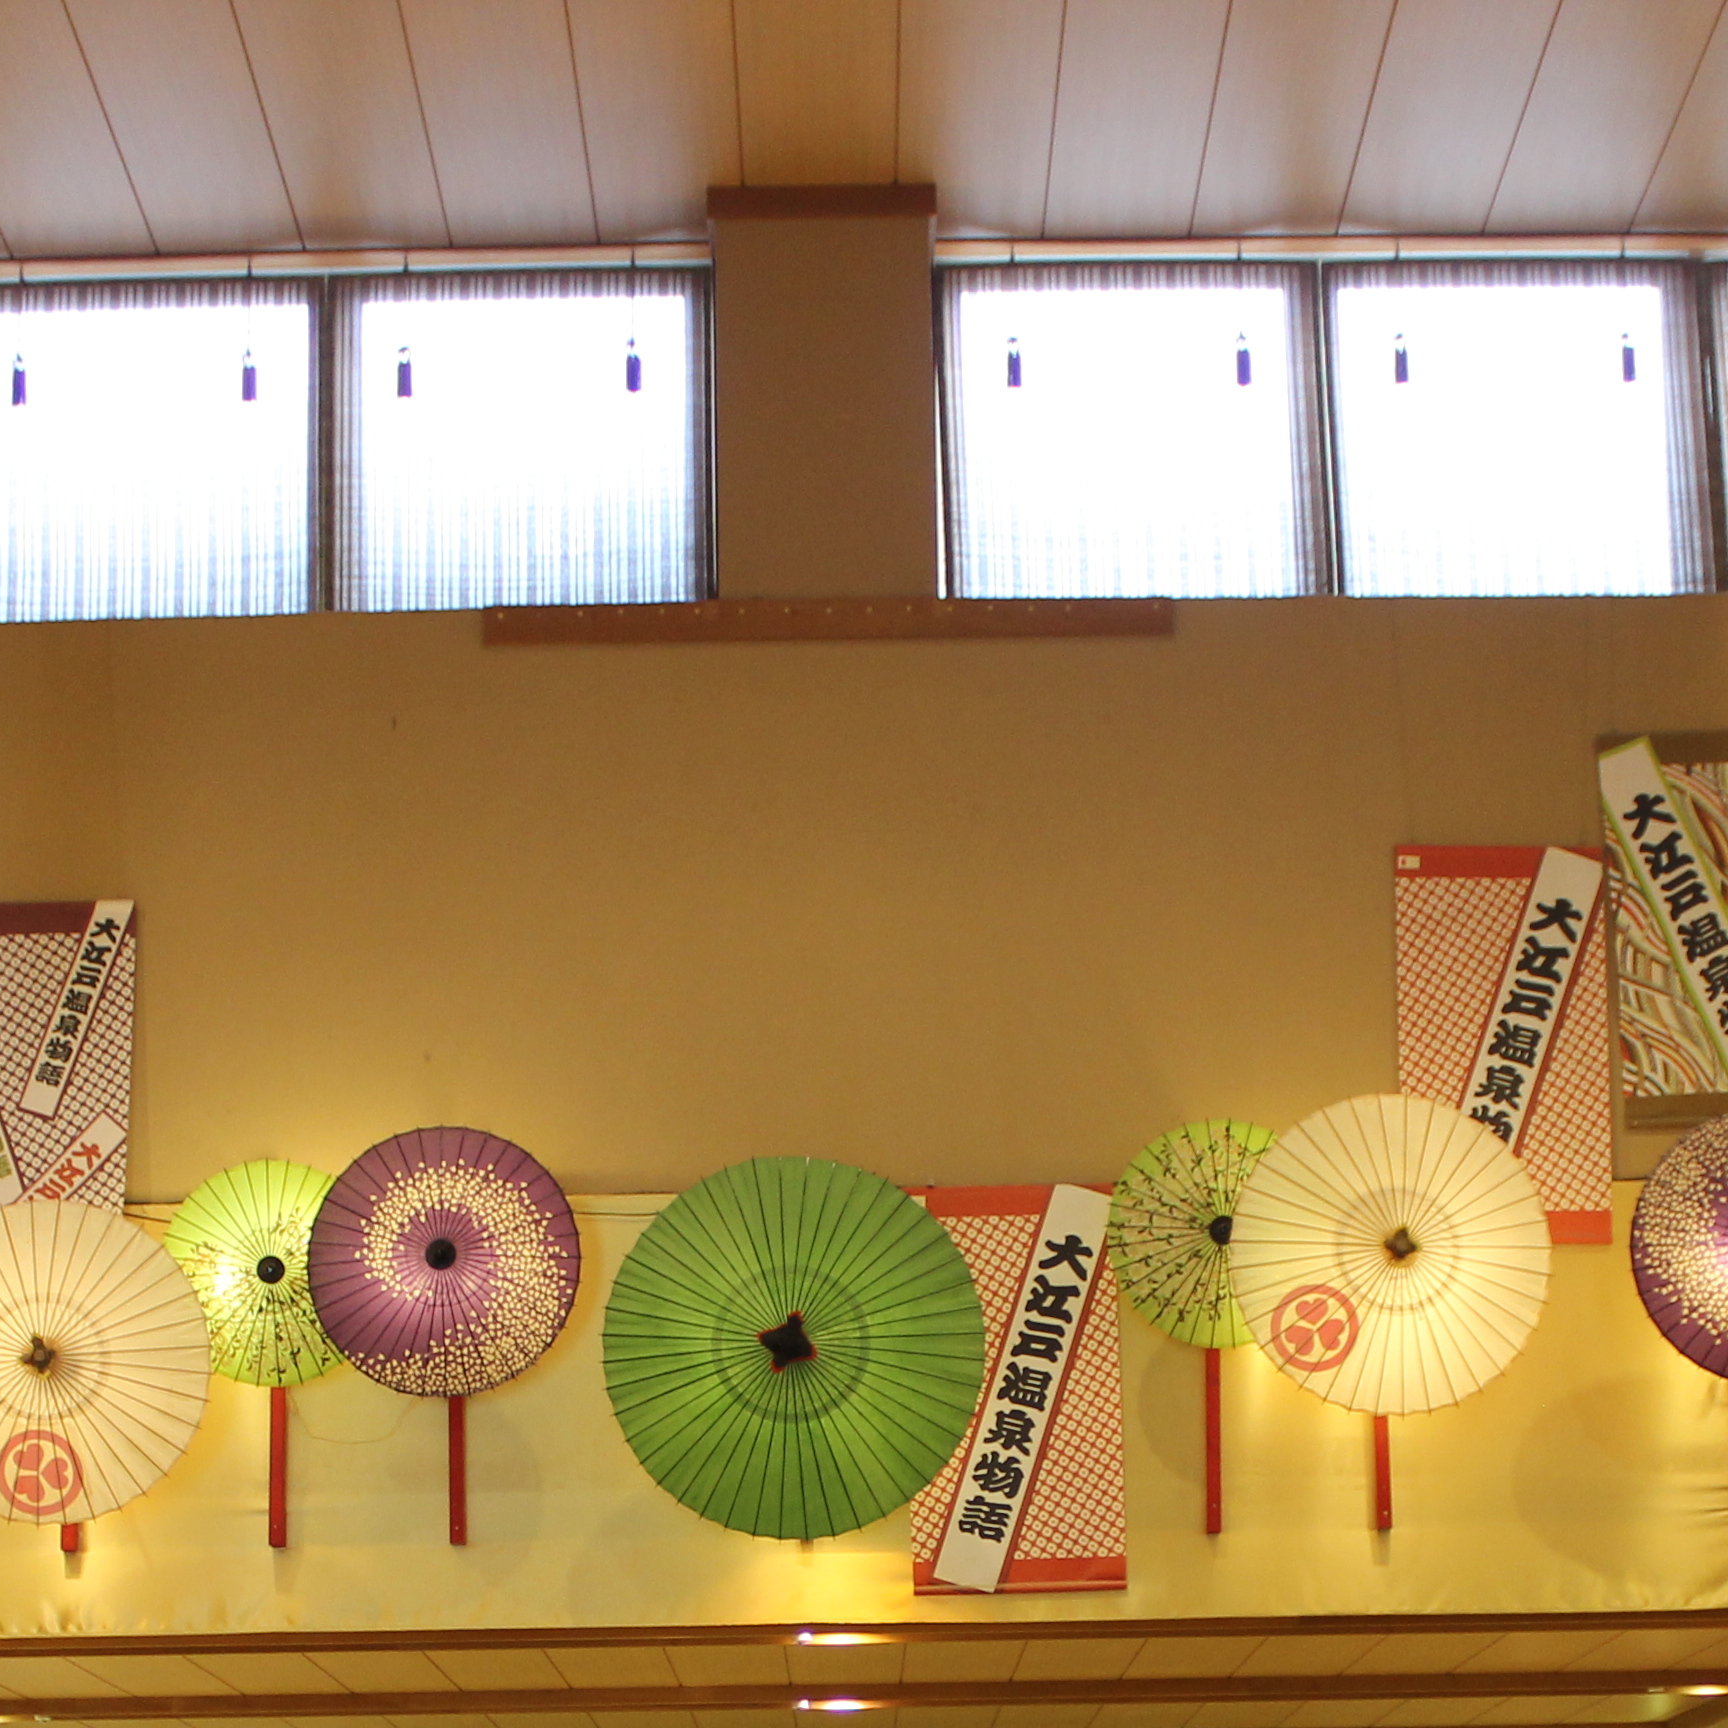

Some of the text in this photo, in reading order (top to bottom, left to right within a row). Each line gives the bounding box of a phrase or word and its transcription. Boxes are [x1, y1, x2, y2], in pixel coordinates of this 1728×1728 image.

[36, 917, 120, 1088] 大江戸温泉物語
[28, 1142, 101, 1200] 大江戸
[958, 1234, 1094, 1544] 大江戸温泉物語
